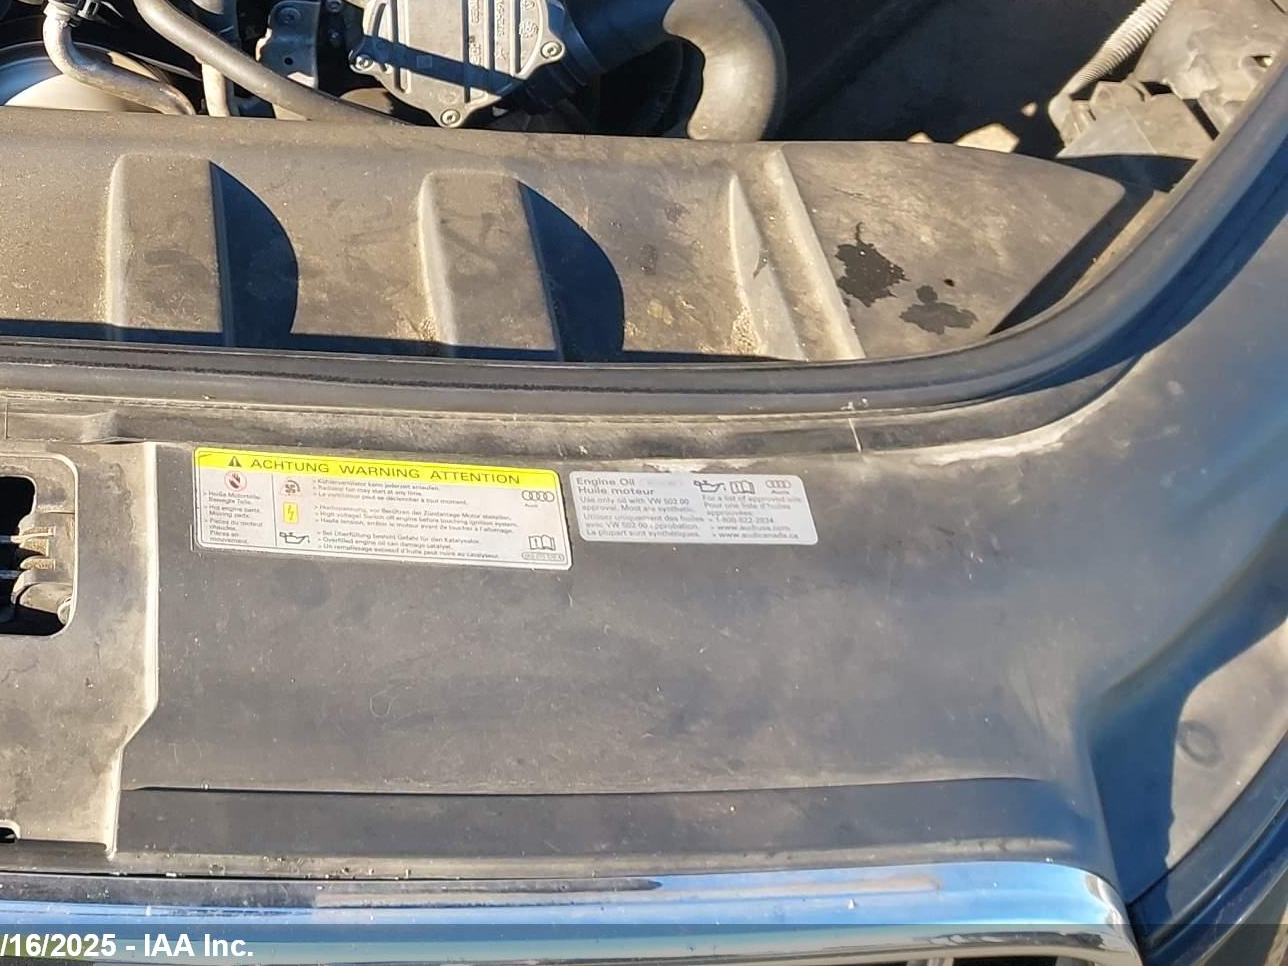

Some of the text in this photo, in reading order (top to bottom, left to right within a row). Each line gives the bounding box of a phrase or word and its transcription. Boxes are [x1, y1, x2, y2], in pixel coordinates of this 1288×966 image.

[250, 459, 520, 484] ACHTUNG WARNING ATTENTION
[576, 477, 616, 487] Engine
[578, 486, 607, 494] Huile
